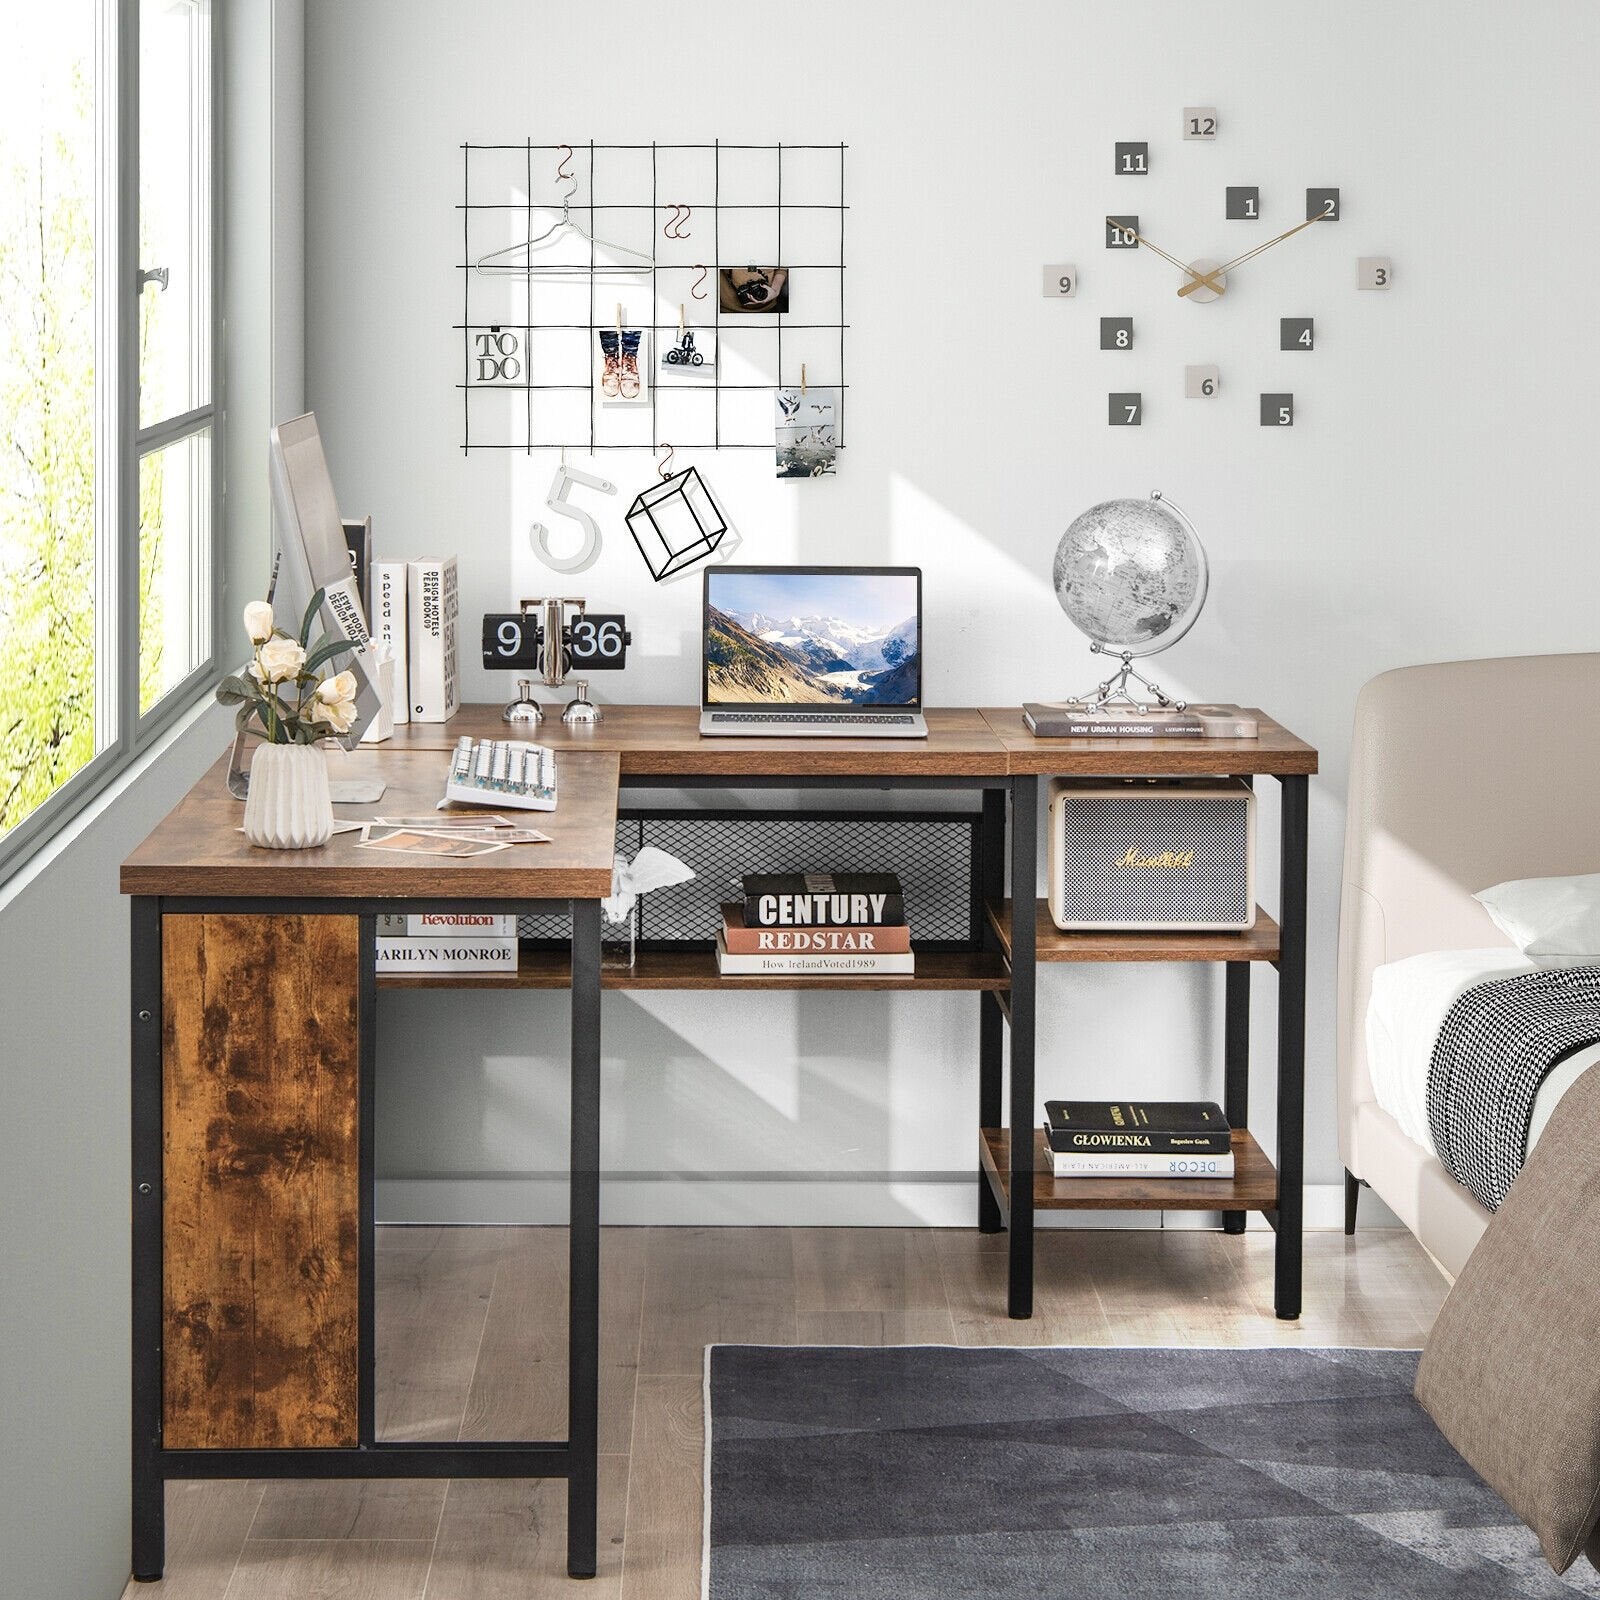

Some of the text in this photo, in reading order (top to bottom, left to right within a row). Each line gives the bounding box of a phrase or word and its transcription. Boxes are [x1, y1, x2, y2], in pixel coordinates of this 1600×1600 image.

[1190, 118, 1215, 135] 12
[1122, 154, 1147, 171] 11
[1245, 199, 1257, 216] 1
[1323, 199, 1335, 217] 2
[1111, 227, 1136, 245] 10
[1059, 276, 1071, 294] 9
[1375, 268, 1387, 286] 3
[475, 333, 519, 357] TO
[1115, 329, 1128, 347] 8
[1299, 329, 1312, 346] 4
[476, 357, 521, 382] DO
[1201, 378, 1214, 396] 6
[1125, 405, 1137, 423] 7
[1279, 407, 1291, 425] 5
[530, 464, 619, 572] 5
[431, 571, 439, 602] DESIGN
[423, 571, 432, 629] YEAR BOOK09
[497, 621, 522, 657] 9
[573, 621, 623, 657] 36
[1070, 725, 1154, 733] NEW URBAN HOUSING
[758, 894, 887, 925] CENTURY
[421, 914, 494, 926] Revolution
[758, 932, 876, 950] REDSTAR
[442, 949, 512, 961] MONROE
[762, 960, 785, 969] How
[1169, 1161, 1216, 1172] DECOR
